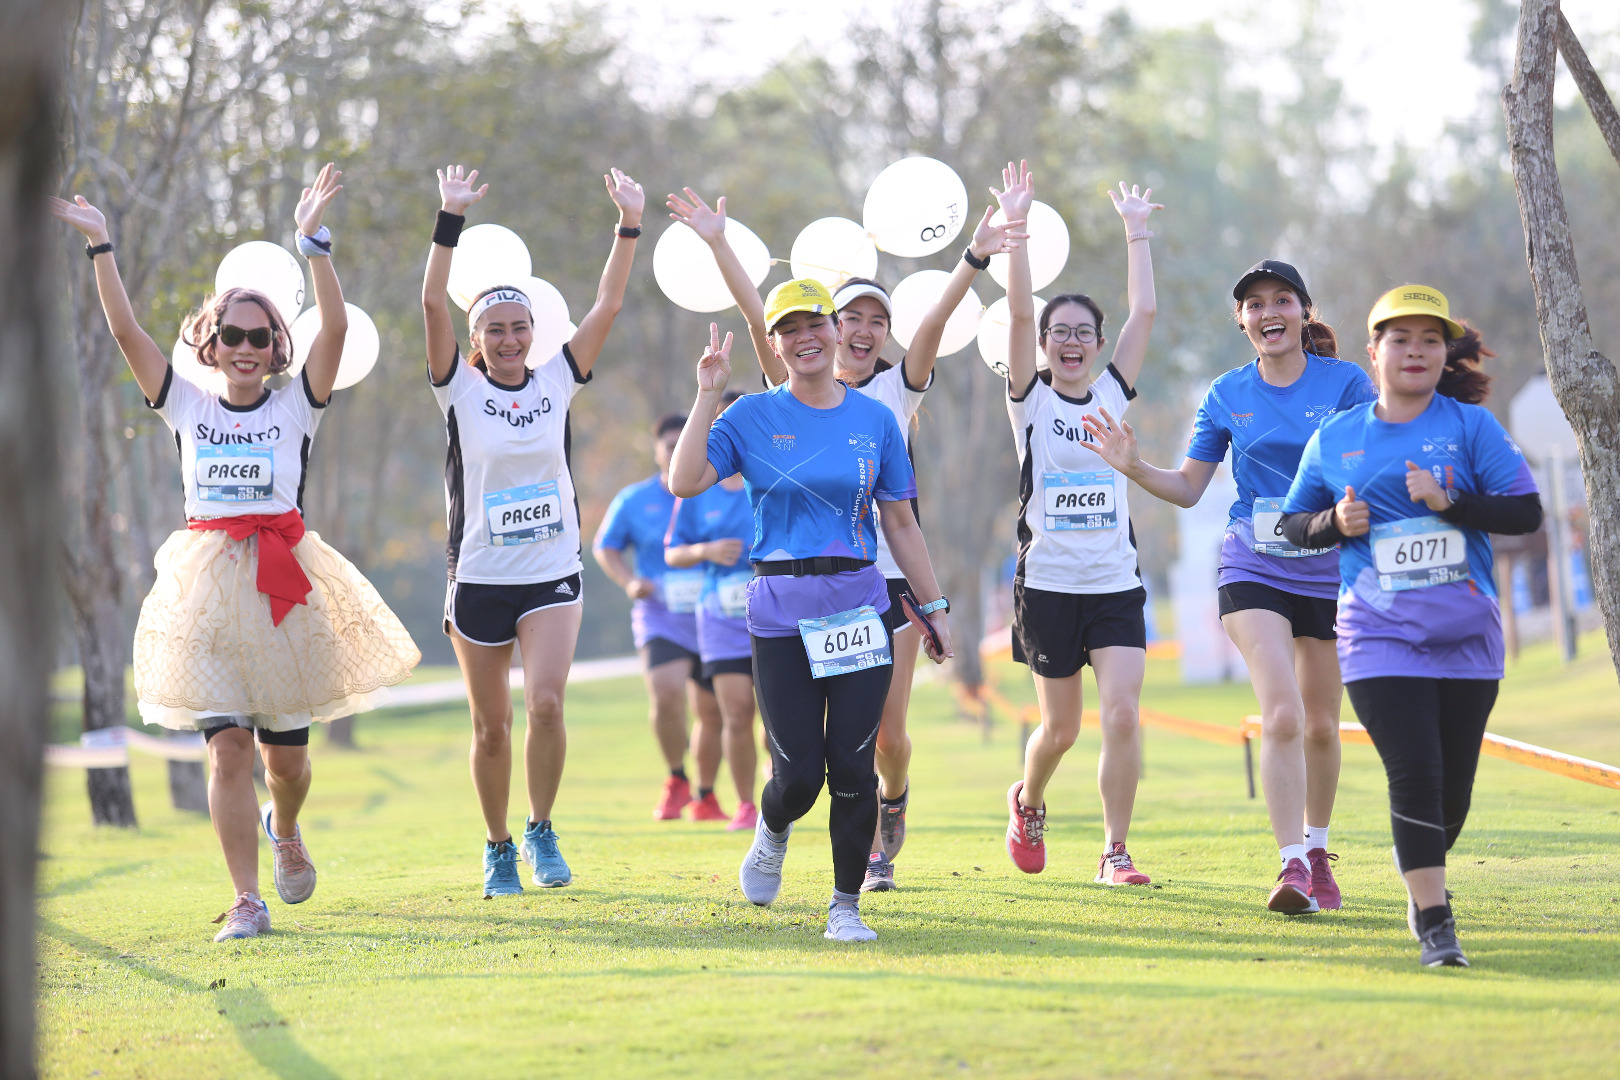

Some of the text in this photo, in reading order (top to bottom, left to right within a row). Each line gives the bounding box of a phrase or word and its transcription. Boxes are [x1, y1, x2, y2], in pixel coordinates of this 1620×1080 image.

[920, 224, 946, 242] 8
[485, 291, 523, 306] FILA
[1403, 292, 1441, 307] SEIKO
[208, 464, 261, 479] PACER
[857, 457, 866, 486] CROSS
[1055, 491, 1106, 508] PACER
[502, 503, 551, 526] PACER
[1395, 536, 1447, 565] 6071
[824, 625, 871, 654] 6041
